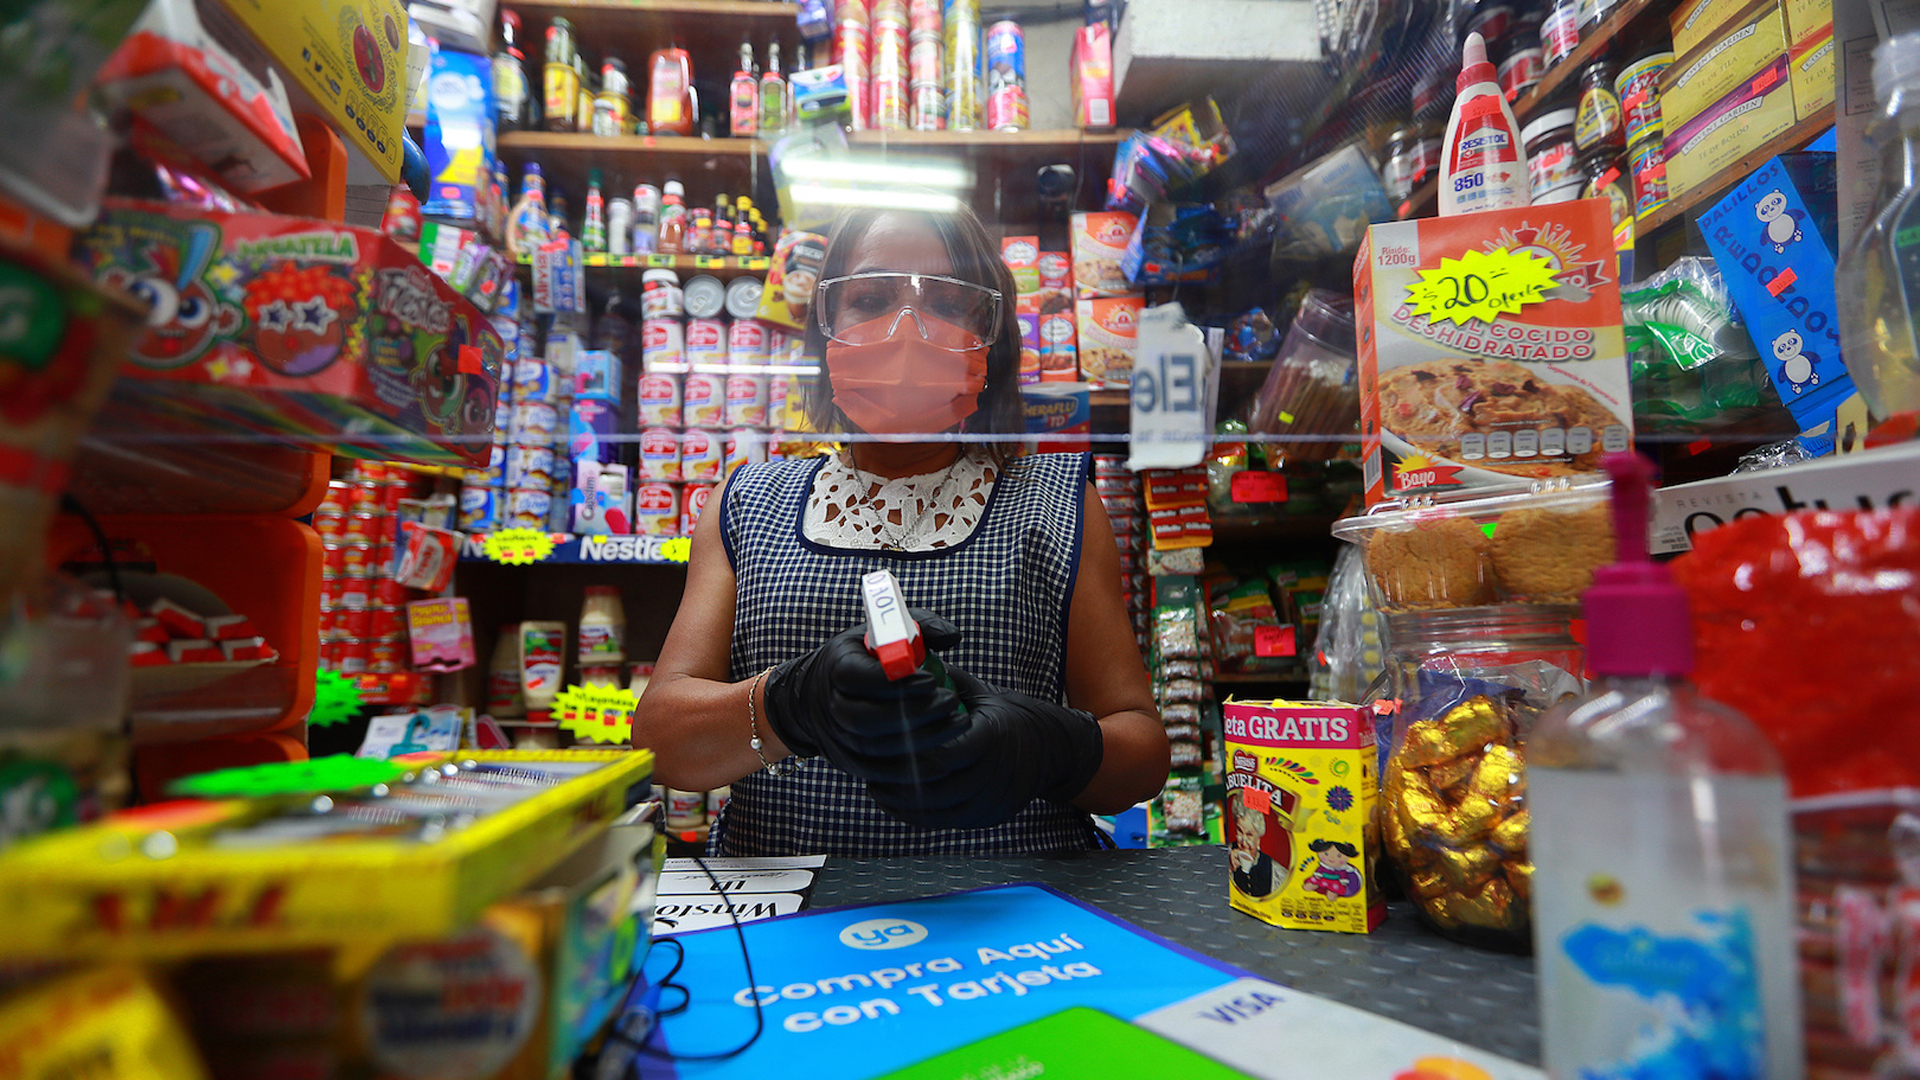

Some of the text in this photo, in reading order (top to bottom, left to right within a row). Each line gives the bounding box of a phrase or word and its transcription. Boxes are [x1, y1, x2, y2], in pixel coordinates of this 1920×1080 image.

[1680, 27, 1752, 85] COVENT GARDEN
[1684, 100, 1758, 151] COVENT GARDEN
[1460, 133, 1507, 152] RESISTOL
[1454, 172, 1484, 192] 850
[1701, 163, 1780, 231] PALILLOS
[1377, 254, 1416, 267] 1200g
[1381, 246, 1411, 256] Rinde:
[1392, 306, 1593, 359] DESHIDRATADO
[1490, 324, 1593, 344] COCIDO
[1400, 469, 1436, 490] Bayo
[1677, 491, 1762, 509] REVISTA
[1249, 716, 1350, 742] GRATIS
[850, 923, 916, 947] ya
[733, 932, 1086, 1008] Compra Aquí
[782, 960, 1103, 1033] con Tarjeta
[1199, 991, 1286, 1026] VISA
